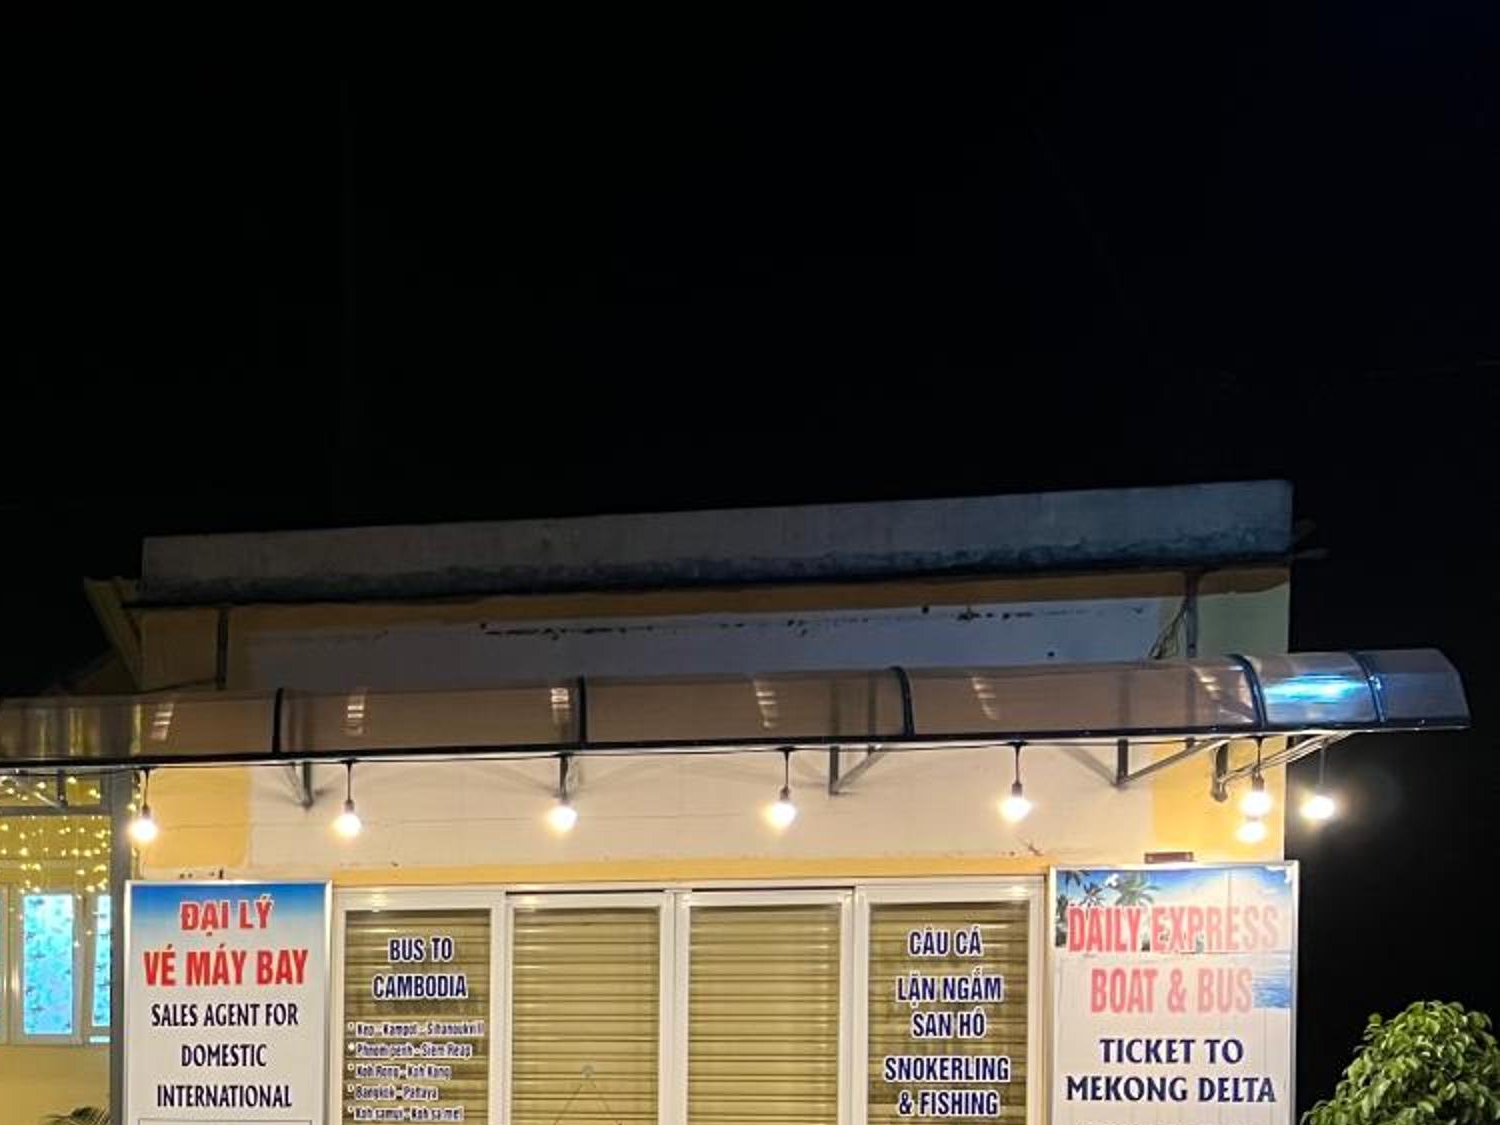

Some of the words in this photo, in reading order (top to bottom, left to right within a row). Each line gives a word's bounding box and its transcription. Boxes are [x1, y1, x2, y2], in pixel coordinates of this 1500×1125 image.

[181, 900, 229, 937] ĐẠI
[240, 893, 274, 930] LÝ
[909, 928, 948, 955] CÂU
[955, 926, 982, 954] CÁ
[1066, 905, 1141, 953] DAILY
[1151, 905, 1280, 953] EXPRESS
[389, 938, 425, 961] BUS
[431, 937, 453, 960] TO
[144, 943, 176, 987] VÉ
[186, 943, 247, 987] MÁY
[257, 949, 308, 985] BAY
[373, 974, 468, 999] CAMBODIA
[1090, 967, 1157, 1014] BOAT
[1167, 967, 1188, 1014] &
[1197, 967, 1253, 1014] BUS
[151, 1003, 198, 1027] SALES
[204, 1003, 260, 1027] AGENT
[265, 1003, 299, 1026] FOR
[912, 1013, 951, 1037] SAN
[959, 1008, 985, 1036] HÔ
[181, 1044, 268, 1067] DOMESTIC
[1100, 1038, 1196, 1063] TICKET
[1204, 1038, 1244, 1064] TO
[885, 1057, 1010, 1081] SNOKERLING
[157, 1084, 293, 1108] INTERNATIONAL
[1065, 1075, 1188, 1102] MEKONG
[1198, 1076, 1276, 1103] DELTA
[898, 1093, 912, 1115] &
[919, 1092, 998, 1115] FISHING
